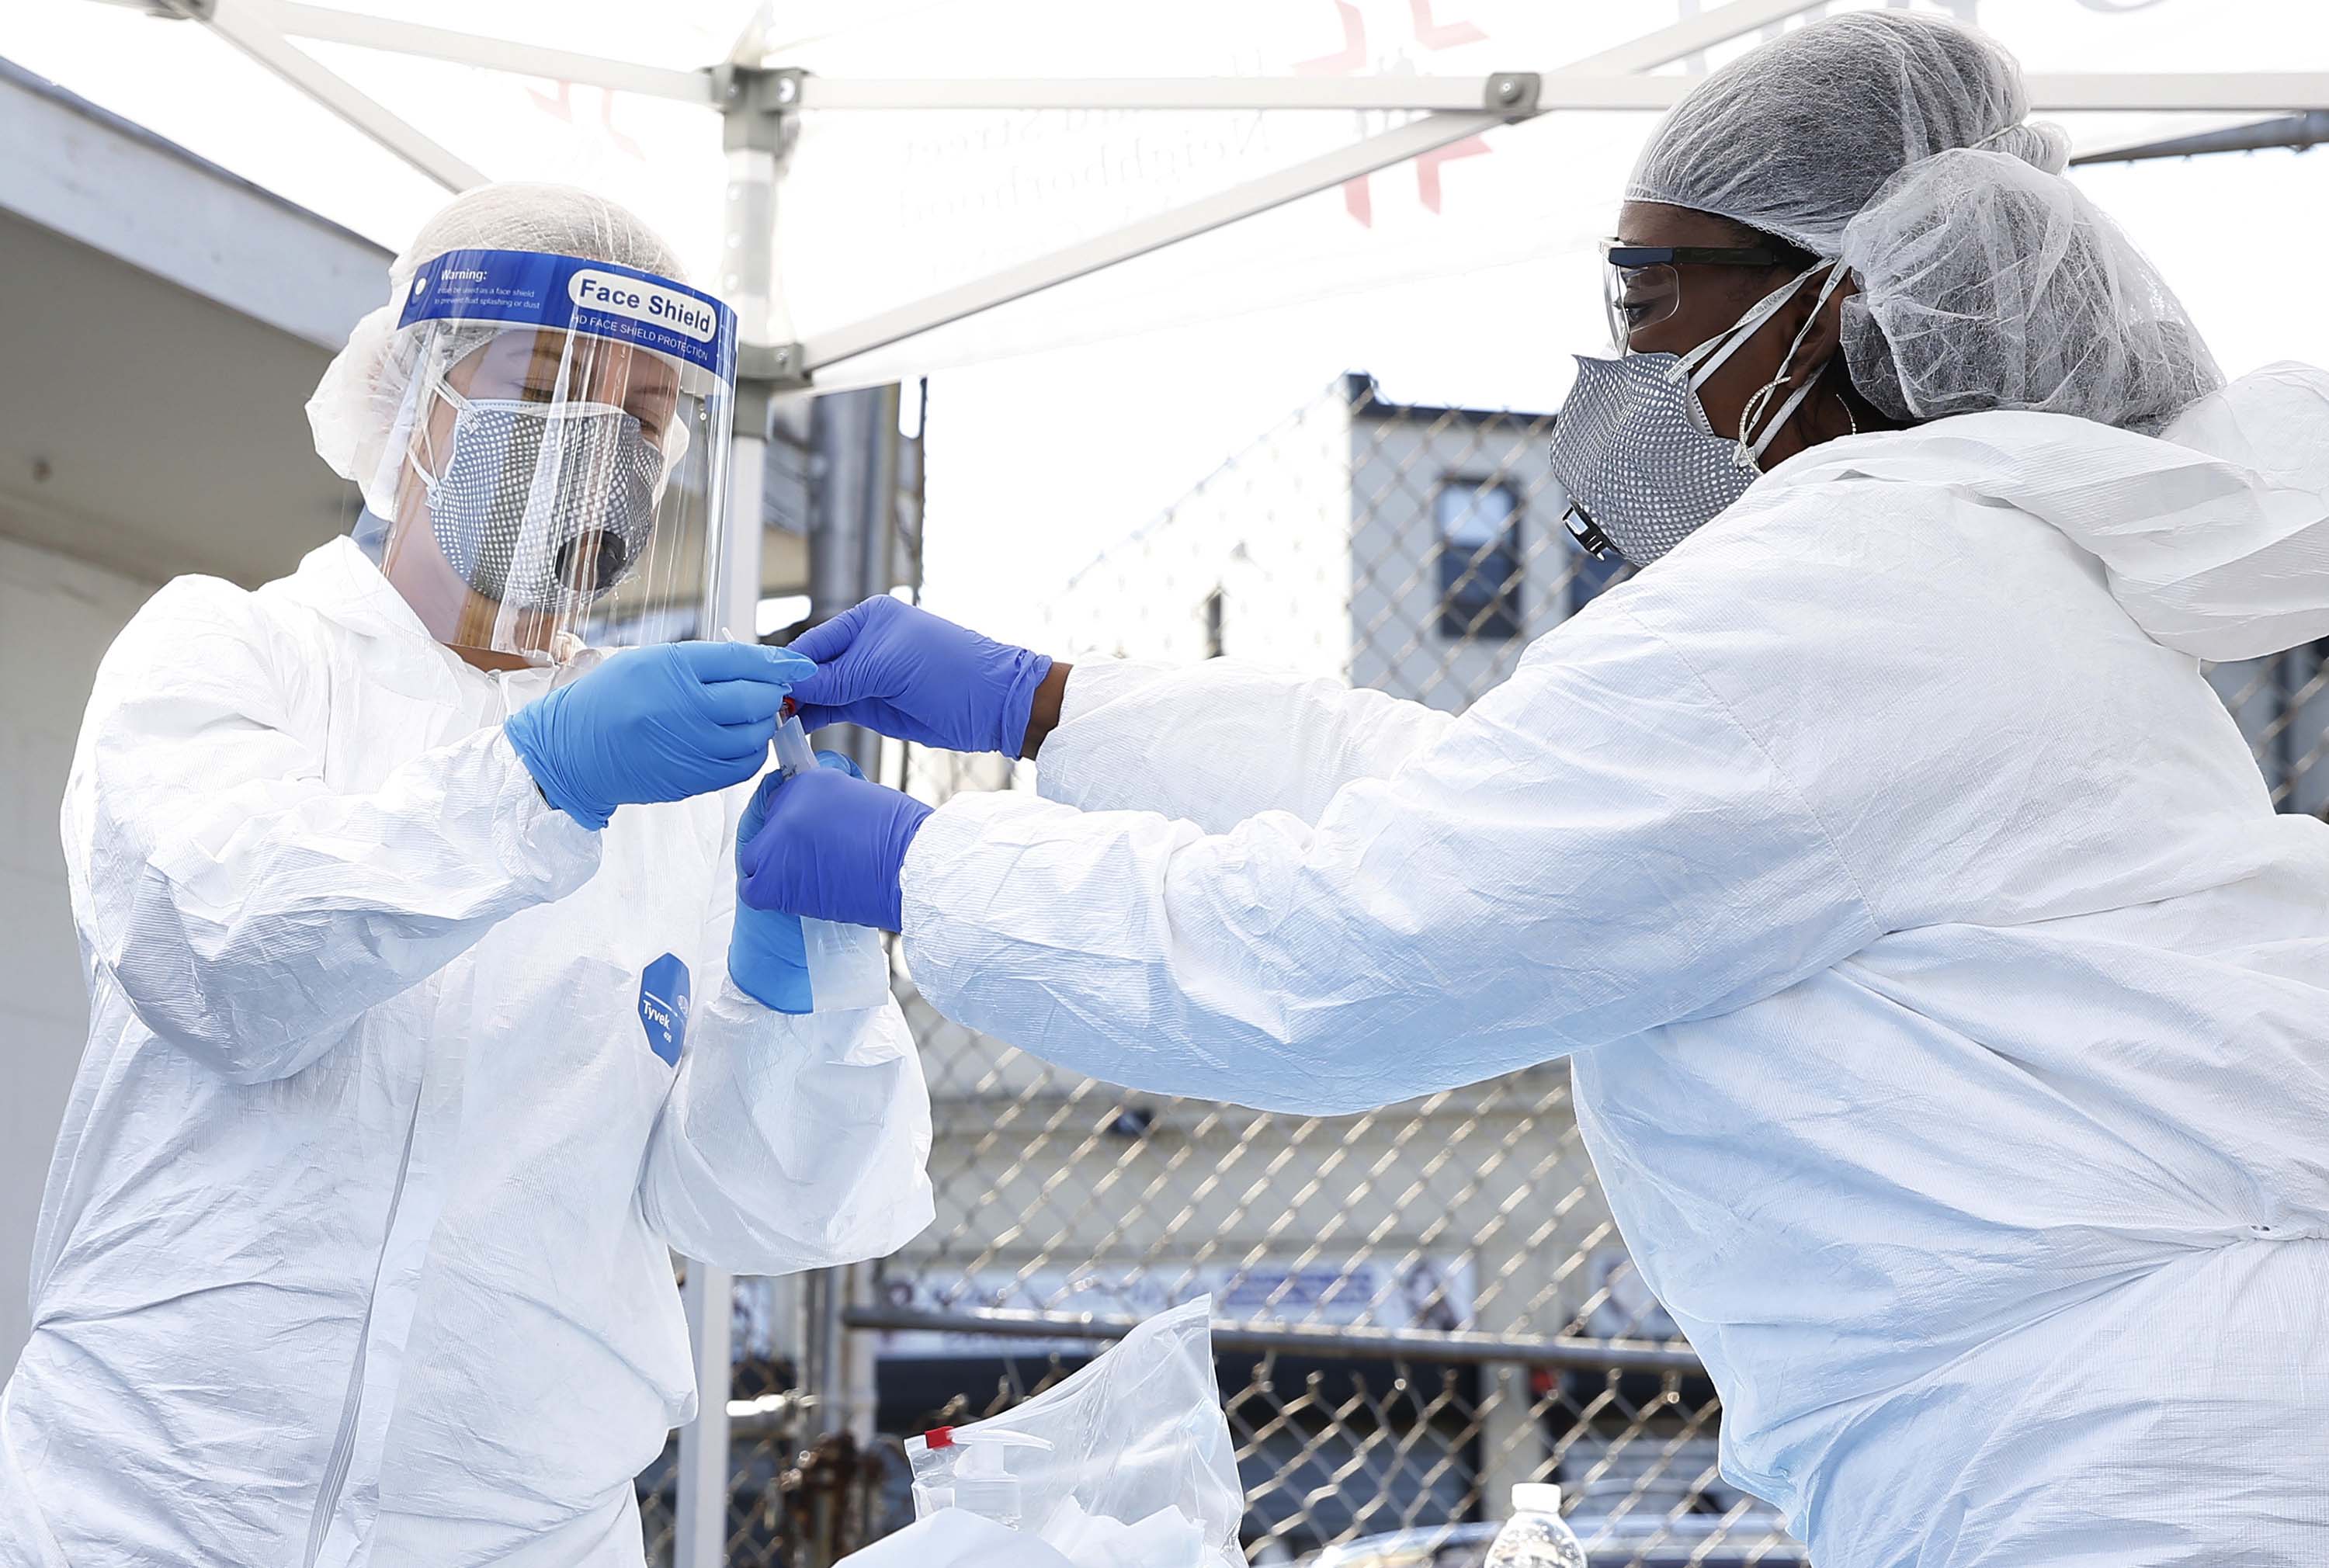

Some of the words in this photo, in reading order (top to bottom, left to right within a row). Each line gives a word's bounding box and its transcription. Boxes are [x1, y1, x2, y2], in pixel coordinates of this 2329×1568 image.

[441, 268, 488, 283] Warning:
[523, 301, 540, 310] dust
[580, 279, 640, 309] Face
[648, 295, 711, 335] Shield
[590, 317, 618, 332] FACE
[620, 323, 656, 342] SHIELD
[658, 335, 709, 361] PROTECTION
[644, 1000, 670, 1030] Tyvek
